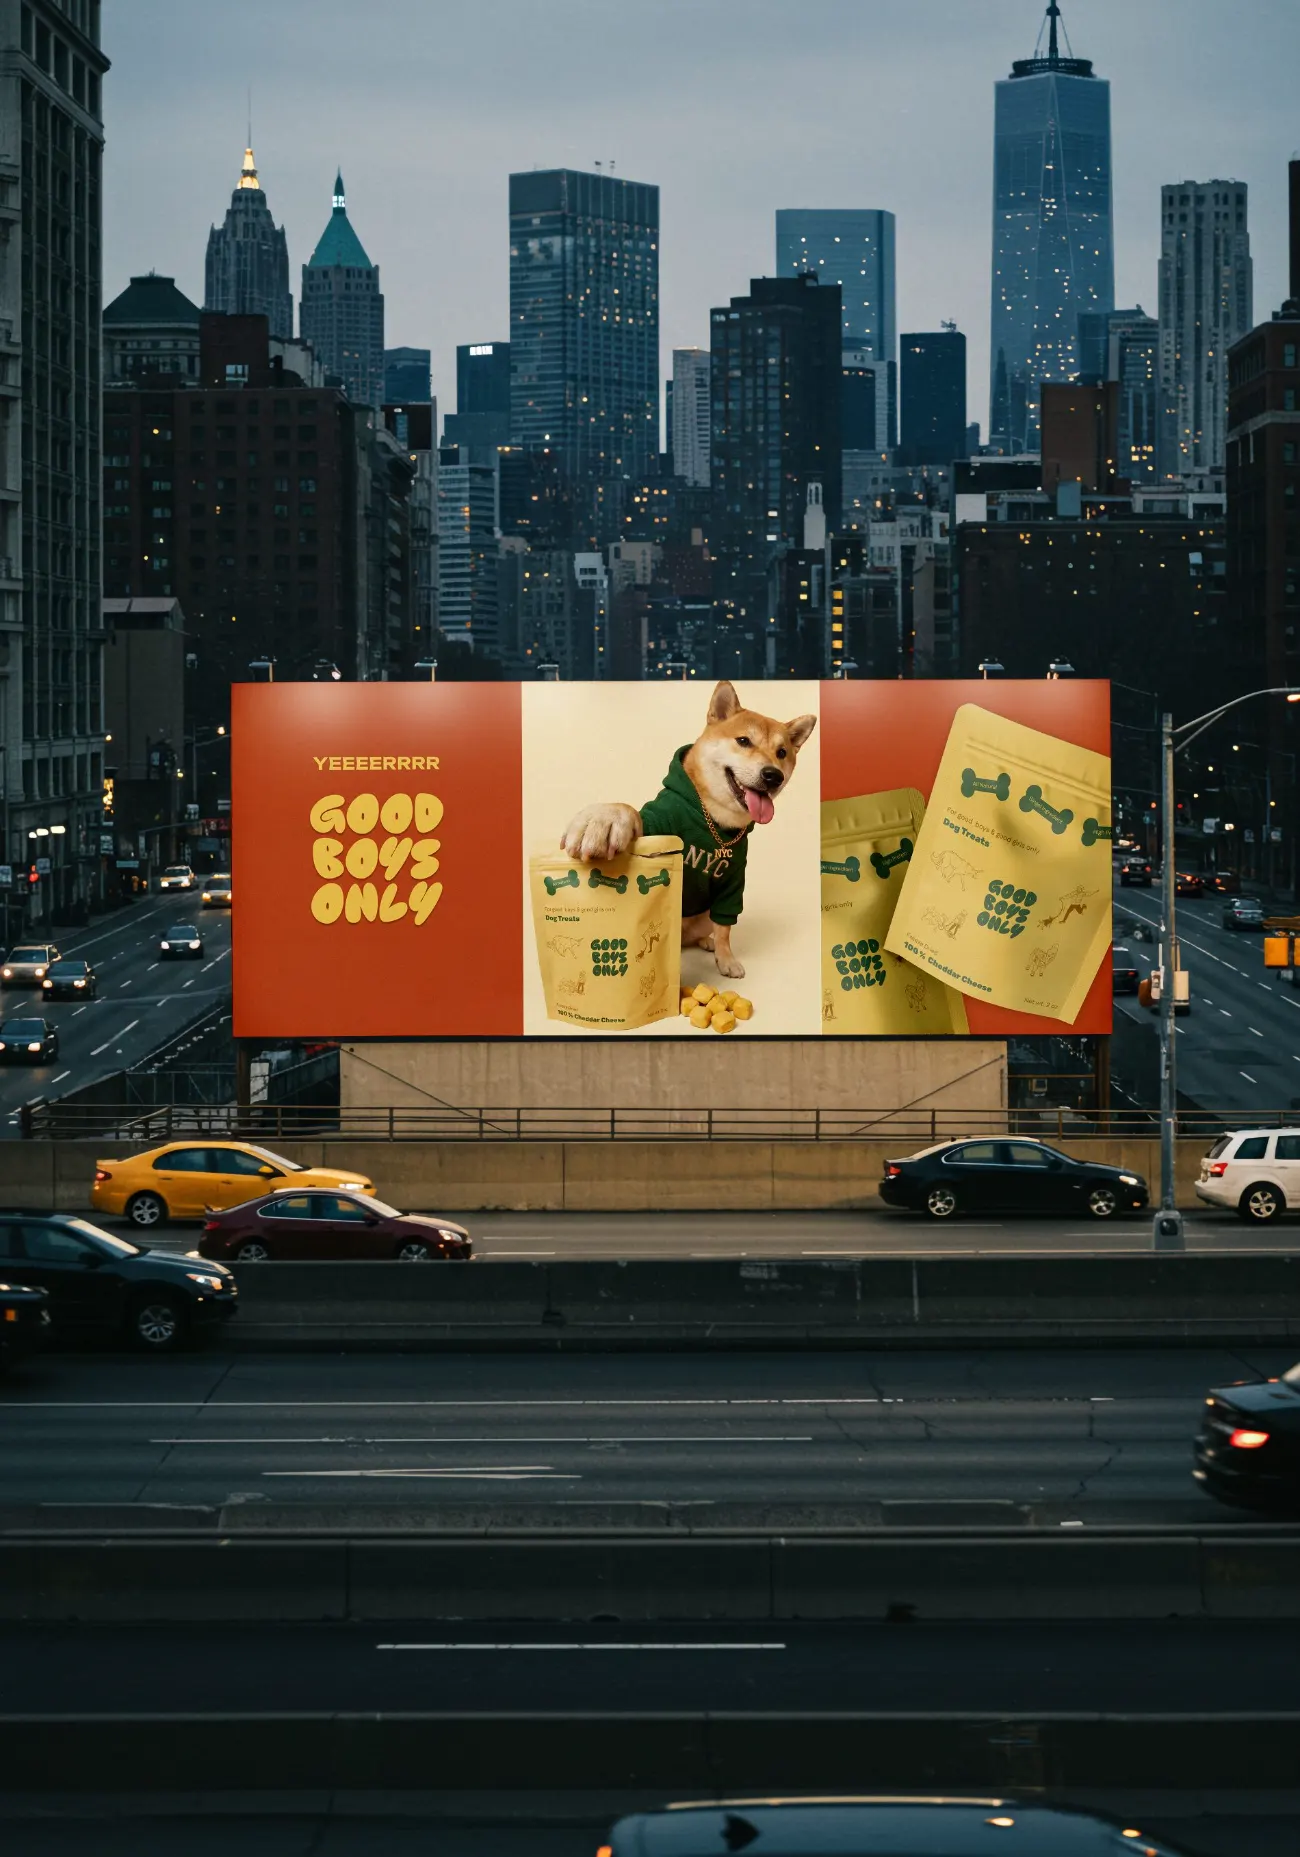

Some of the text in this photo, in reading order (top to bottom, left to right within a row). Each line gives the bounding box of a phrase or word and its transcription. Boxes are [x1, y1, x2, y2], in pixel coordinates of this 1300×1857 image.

[313, 756, 440, 771] YEEEERRRR
[310, 793, 444, 835] GOOD
[943, 818, 990, 848] Dog Treats
[946, 807, 957, 815] For
[957, 813, 973, 825] good
[975, 820, 990, 833] boys
[996, 832, 1012, 843] good
[1026, 845, 1040, 855] only
[312, 836, 441, 881] BOYS
[684, 844, 729, 878] NYC
[715, 848, 733, 858] NYC
[311, 881, 443, 926] ONLY
[988, 879, 1037, 907] GOOD
[984, 893, 1030, 923] BOYS
[977, 911, 1025, 939] ONLY
[591, 938, 628, 951] GOOD
[592, 951, 628, 964] BOYS
[831, 938, 880, 959] GOOD
[592, 964, 629, 977] ONLY
[836, 954, 883, 975] BOYS
[904, 941, 992, 993] 100 % Cheddar Cheese
[841, 969, 886, 991] ONLY
[574, 1014, 600, 1023] Cheddar
